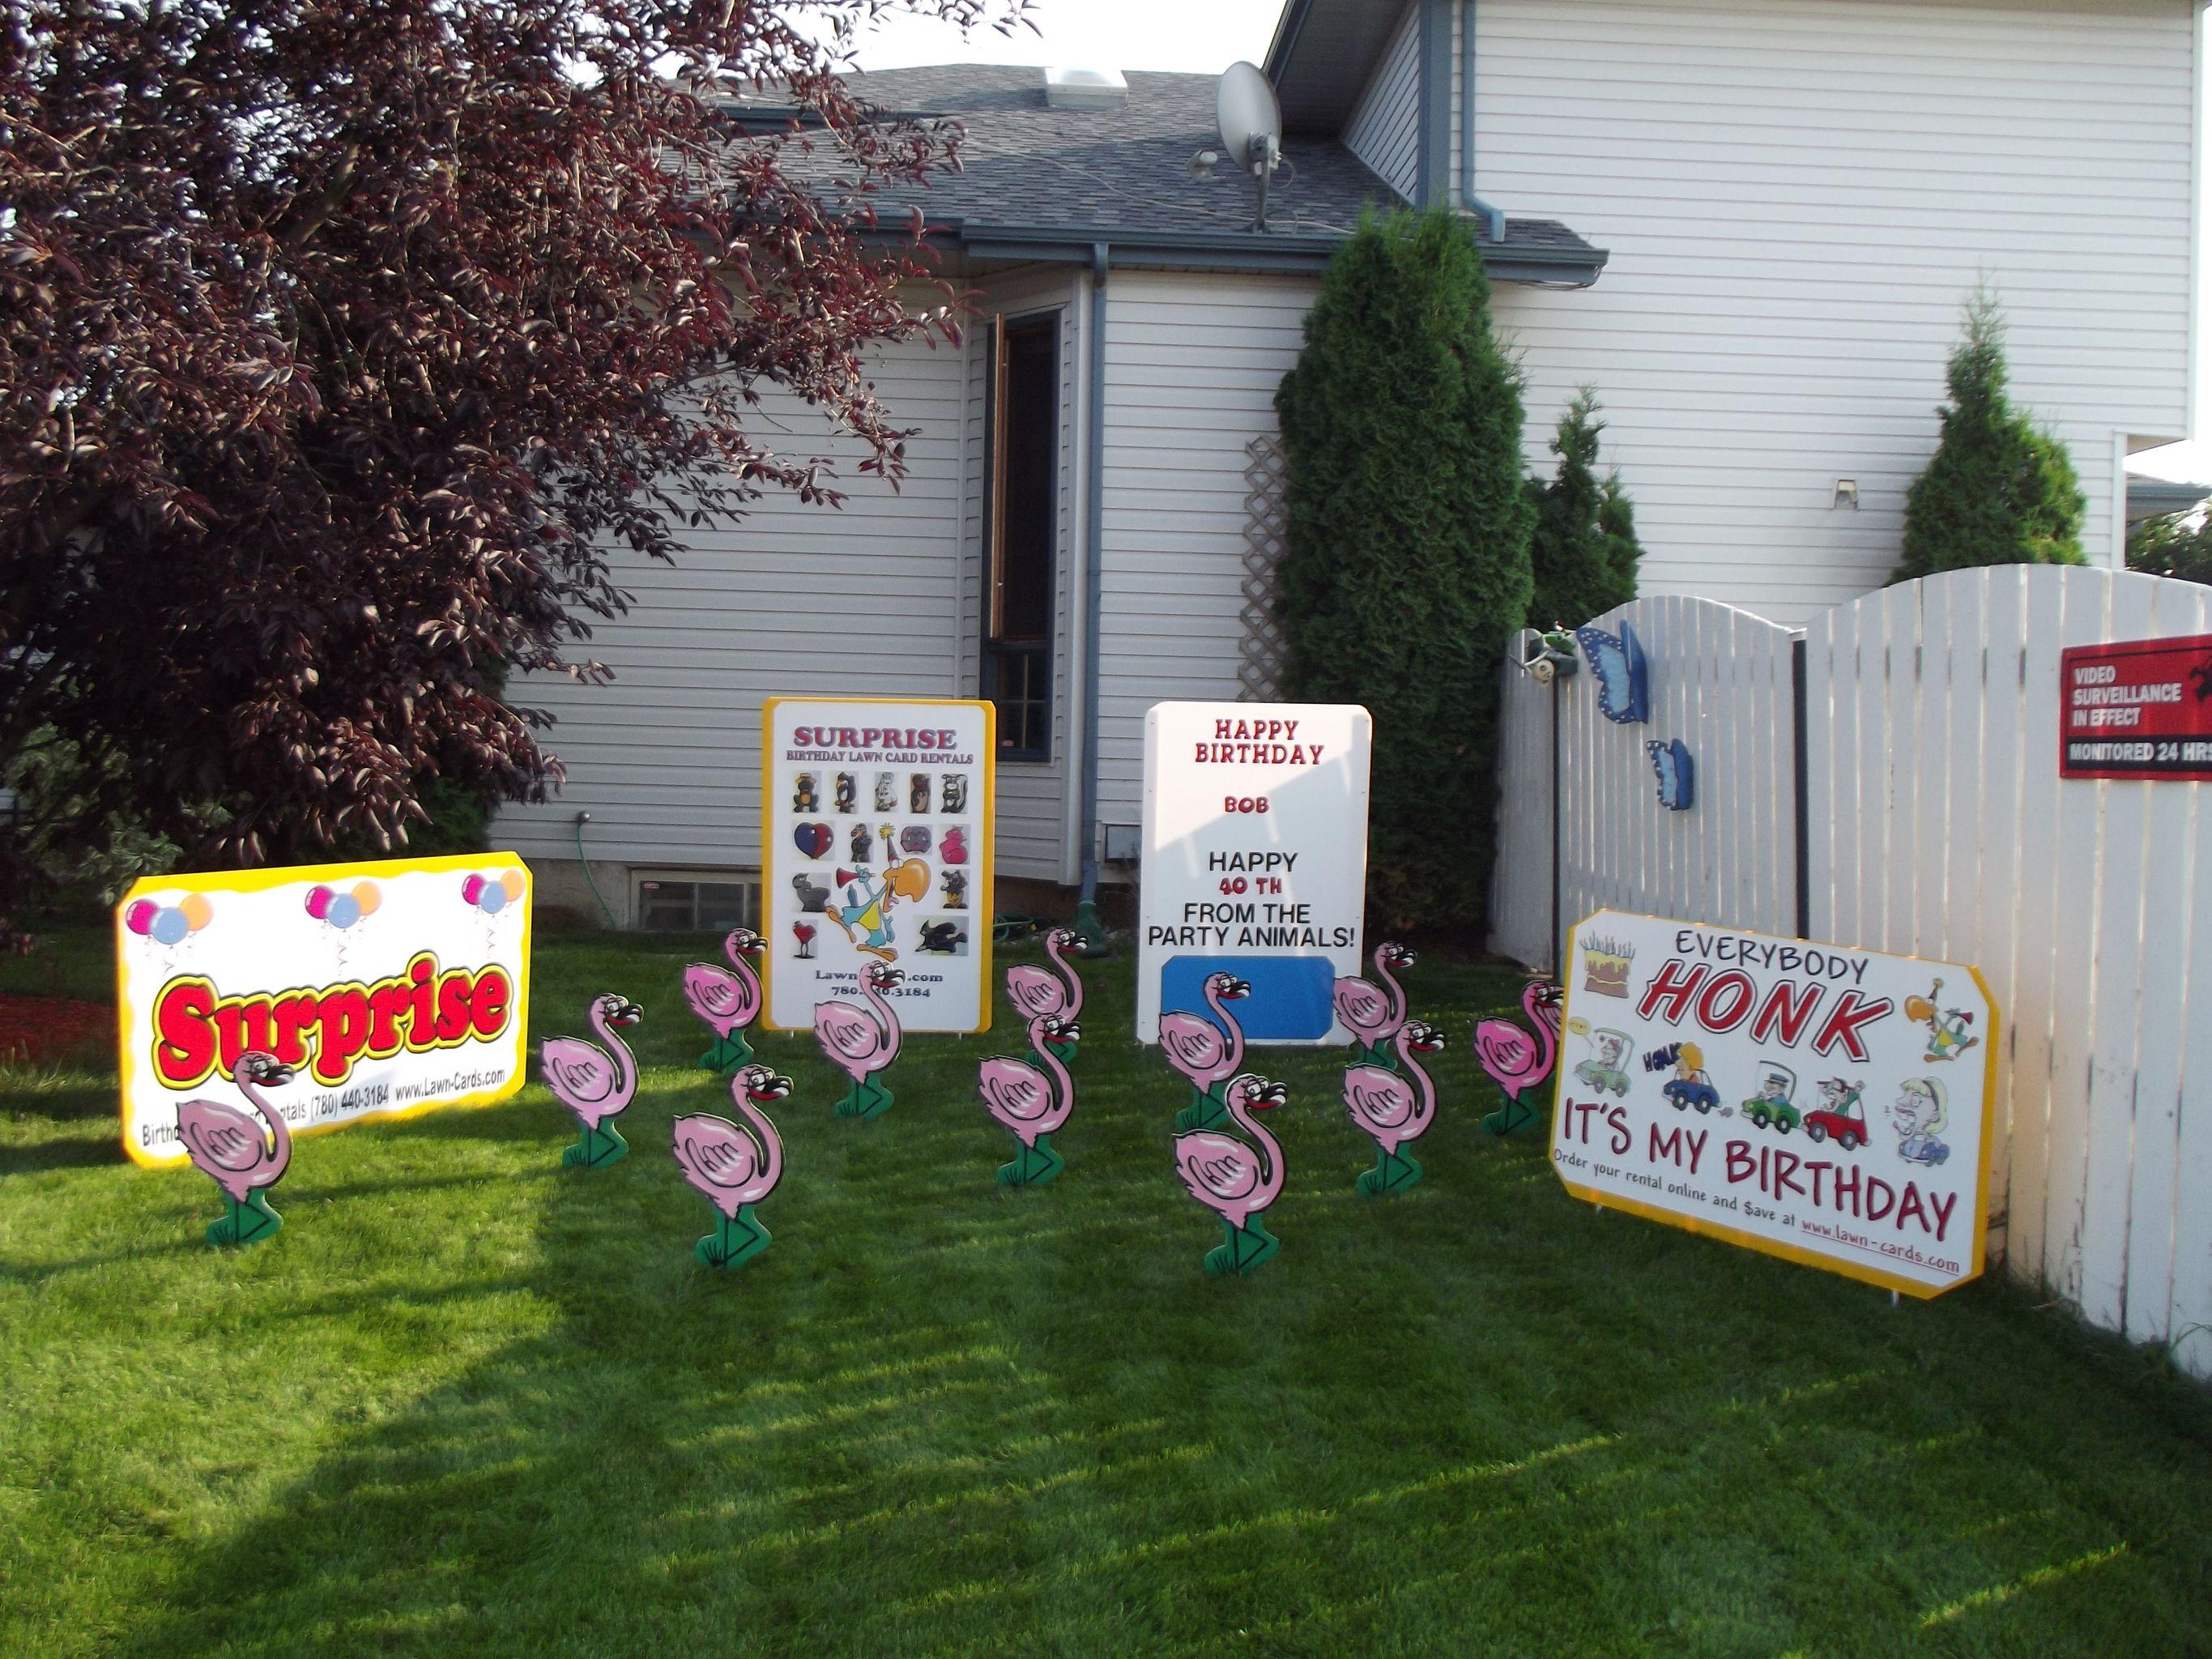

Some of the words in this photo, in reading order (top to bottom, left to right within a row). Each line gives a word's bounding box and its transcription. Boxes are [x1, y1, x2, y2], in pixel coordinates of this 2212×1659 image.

[2073, 665, 2116, 684] VIDEO
[2072, 682, 2182, 706] SURVEILLANCE
[2072, 710, 2087, 727] IN
[2089, 707, 2141, 727] EFFECT
[794, 726, 957, 750] SURPRISE
[1215, 719, 1299, 740] HAPPY
[786, 750, 846, 761] BIRTHDAY
[849, 751, 884, 763] LAWN
[885, 753, 918, 764] CARD
[921, 753, 974, 765] RENTALS
[1195, 743, 1324, 765] BIRTHDAY
[2069, 742, 2154, 761] MONITORED
[2157, 741, 2179, 761] 24
[1224, 795, 1269, 814] BOB
[1208, 851, 1298, 872] HAPPY
[1219, 876, 1248, 896] 40
[1256, 876, 1282, 895] TH
[1183, 902, 1255, 924] FROM
[1263, 903, 1311, 924] THE
[1148, 926, 1230, 947] PARTY
[1237, 927, 1355, 948] ANIMALS!
[1675, 929, 1870, 984] EVERYBODY
[153, 950, 512, 1088] Surprise
[1636, 957, 1894, 1062] HONK
[1643, 1042, 1682, 1072] HONK
[143, 1121, 179, 1147] Birth
[310, 1094, 338, 1121] (780)
[341, 1083, 390, 1111] 440-3184
[395, 1068, 505, 1101] www.Lawn-Cards.com
[1564, 1097, 1631, 1154] IT'S
[1649, 1122, 1708, 1174] MY
[1726, 1140, 1958, 1242] BIRTHDAY
[1554, 1148, 1588, 1168] Order
[1593, 1163, 1621, 1178] your
[1626, 1171, 1662, 1189] rental
[1668, 1182, 1707, 1201] online
[1713, 1193, 1737, 1210] and
[1782, 1213, 1796, 1226] at
